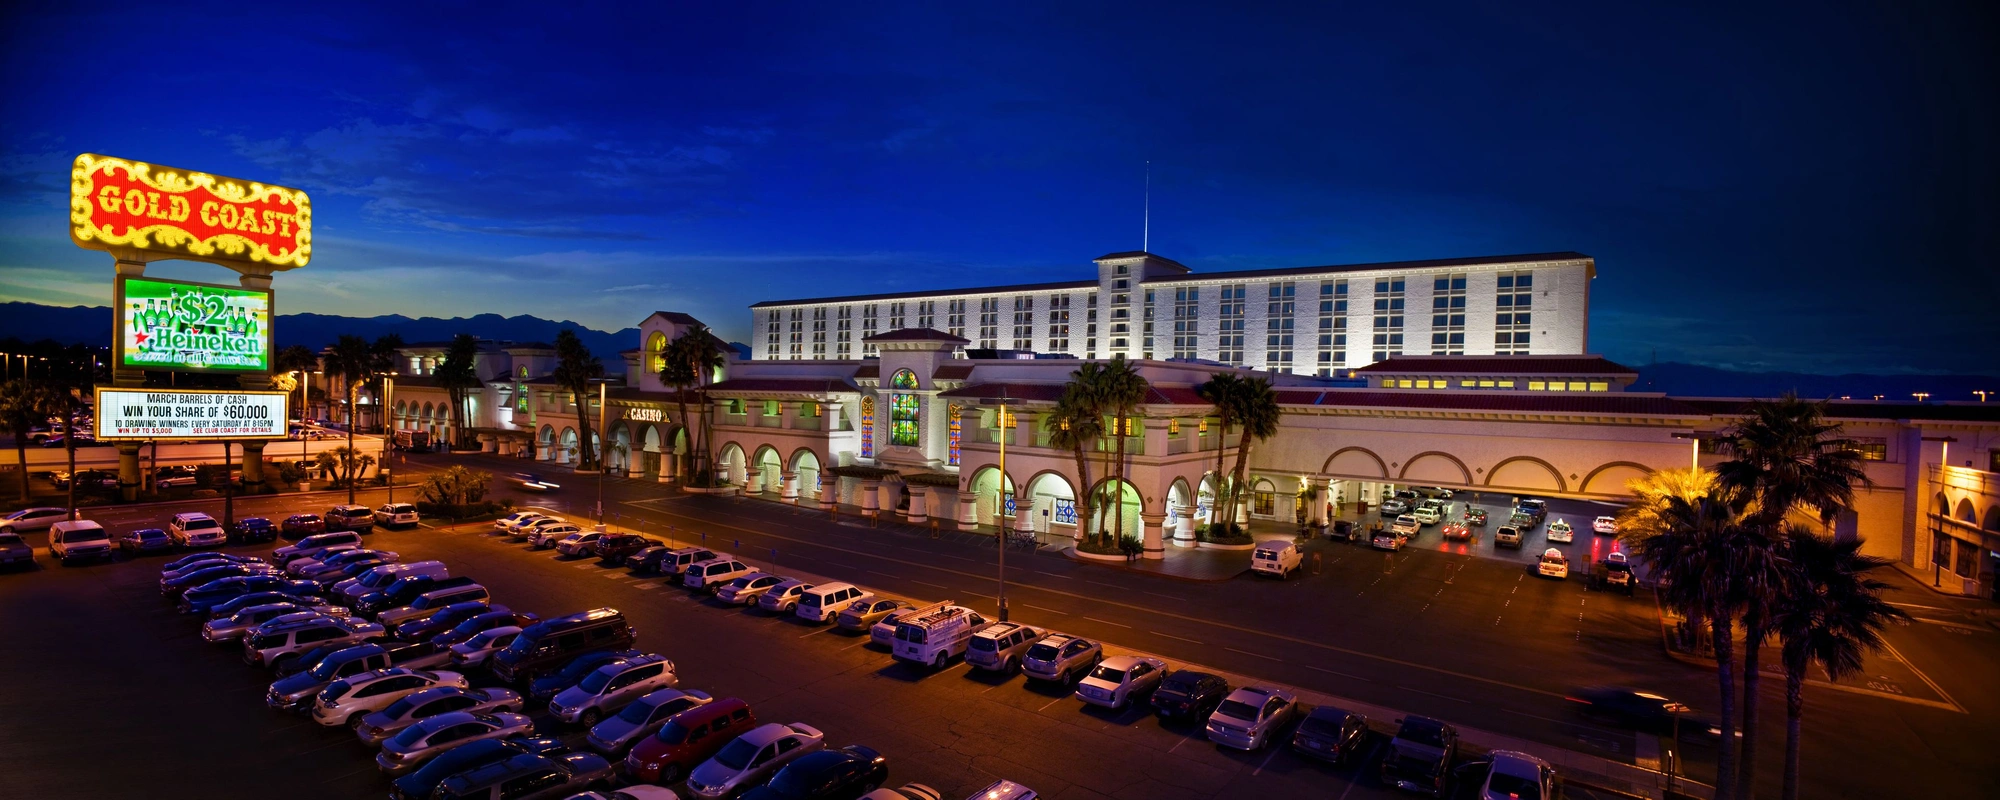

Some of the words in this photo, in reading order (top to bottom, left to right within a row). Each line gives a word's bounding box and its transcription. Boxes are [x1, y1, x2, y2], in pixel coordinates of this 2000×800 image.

[97, 185, 190, 222] GOLD
[200, 201, 296, 238] COAST
[180, 292, 227, 326] $2
[155, 328, 259, 353] Heineken
[147, 394, 177, 404] MARCH
[179, 395, 212, 404] BARRELS
[215, 395, 224, 404] OF
[227, 395, 247, 404] CASH
[123, 405, 143, 417] WIN
[147, 406, 172, 417] YOUR
[175, 406, 205, 418] SHARE
[208, 406, 219, 418] OF
[223, 405, 268, 419] $60,000
[631, 408, 661, 421] CASINO
[115, 419, 123, 427] 10
[125, 419, 157, 428] DRAWING
[159, 419, 189, 428] WINNERS
[191, 420, 210, 428] EVERY
[211, 419, 242, 428] SATURDAY
[243, 419, 251, 428] AT
[1867, 680, 1903, 694] STOP
